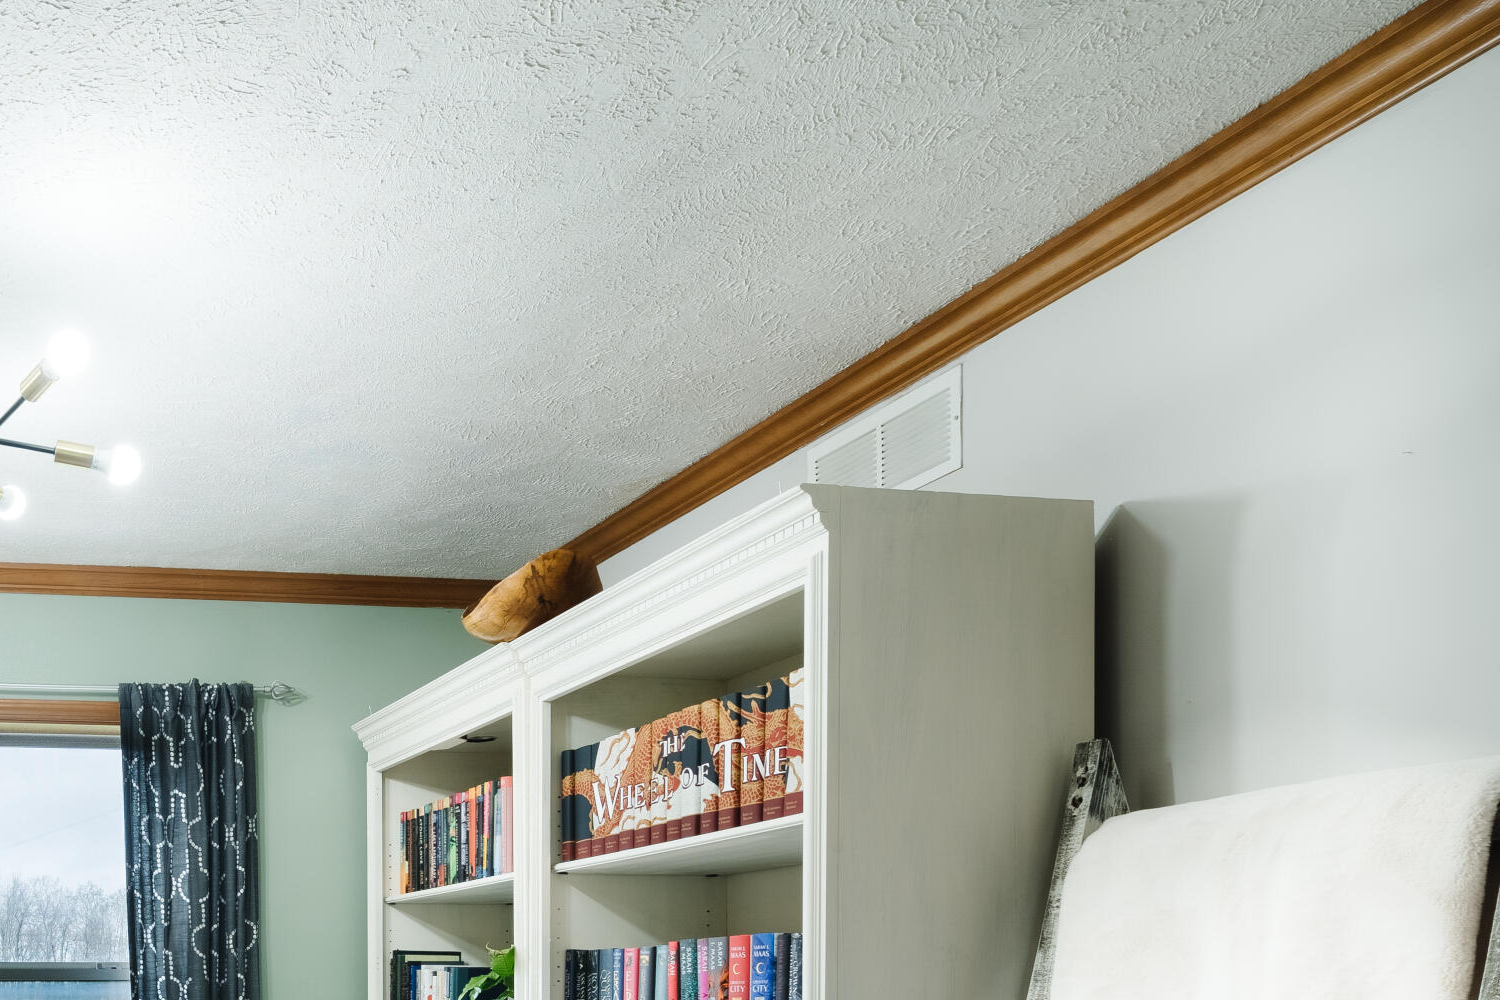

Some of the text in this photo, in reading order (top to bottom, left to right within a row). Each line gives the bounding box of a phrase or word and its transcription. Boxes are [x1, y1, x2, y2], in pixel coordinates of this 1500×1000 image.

[659, 733, 686, 758] THE
[592, 737, 789, 826] WHEEL OF TIME
[730, 951, 747, 959] MAAS
[730, 984, 746, 993] CITY
[752, 984, 769, 993] CITY
